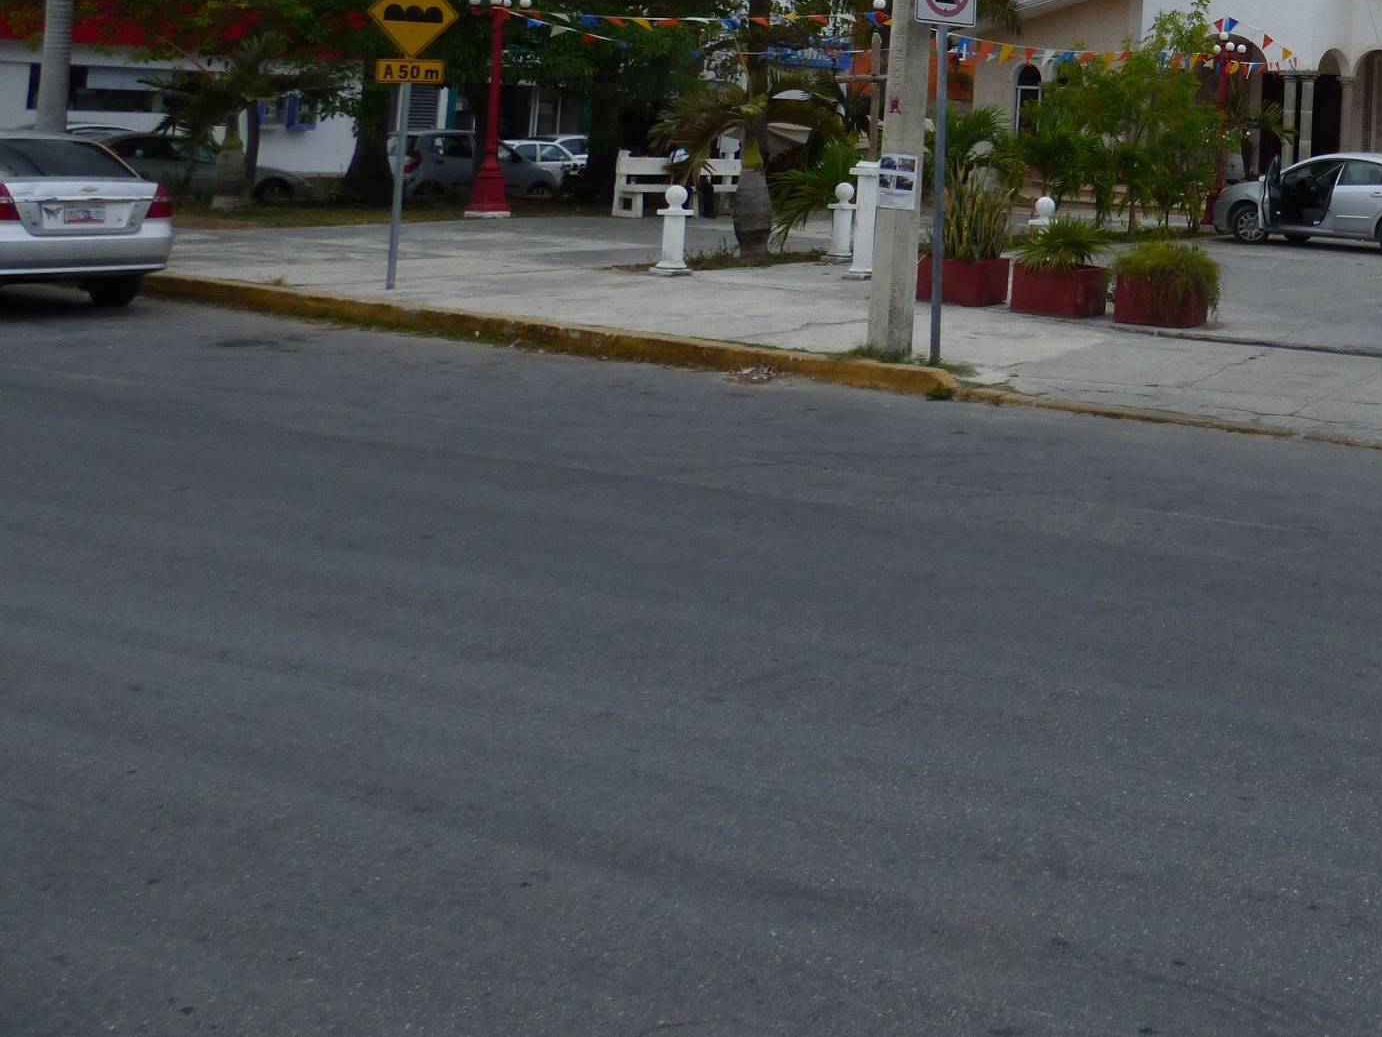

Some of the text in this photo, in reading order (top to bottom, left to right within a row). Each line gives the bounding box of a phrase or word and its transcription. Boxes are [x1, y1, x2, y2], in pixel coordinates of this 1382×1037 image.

[383, 64, 439, 79] A 50 m
